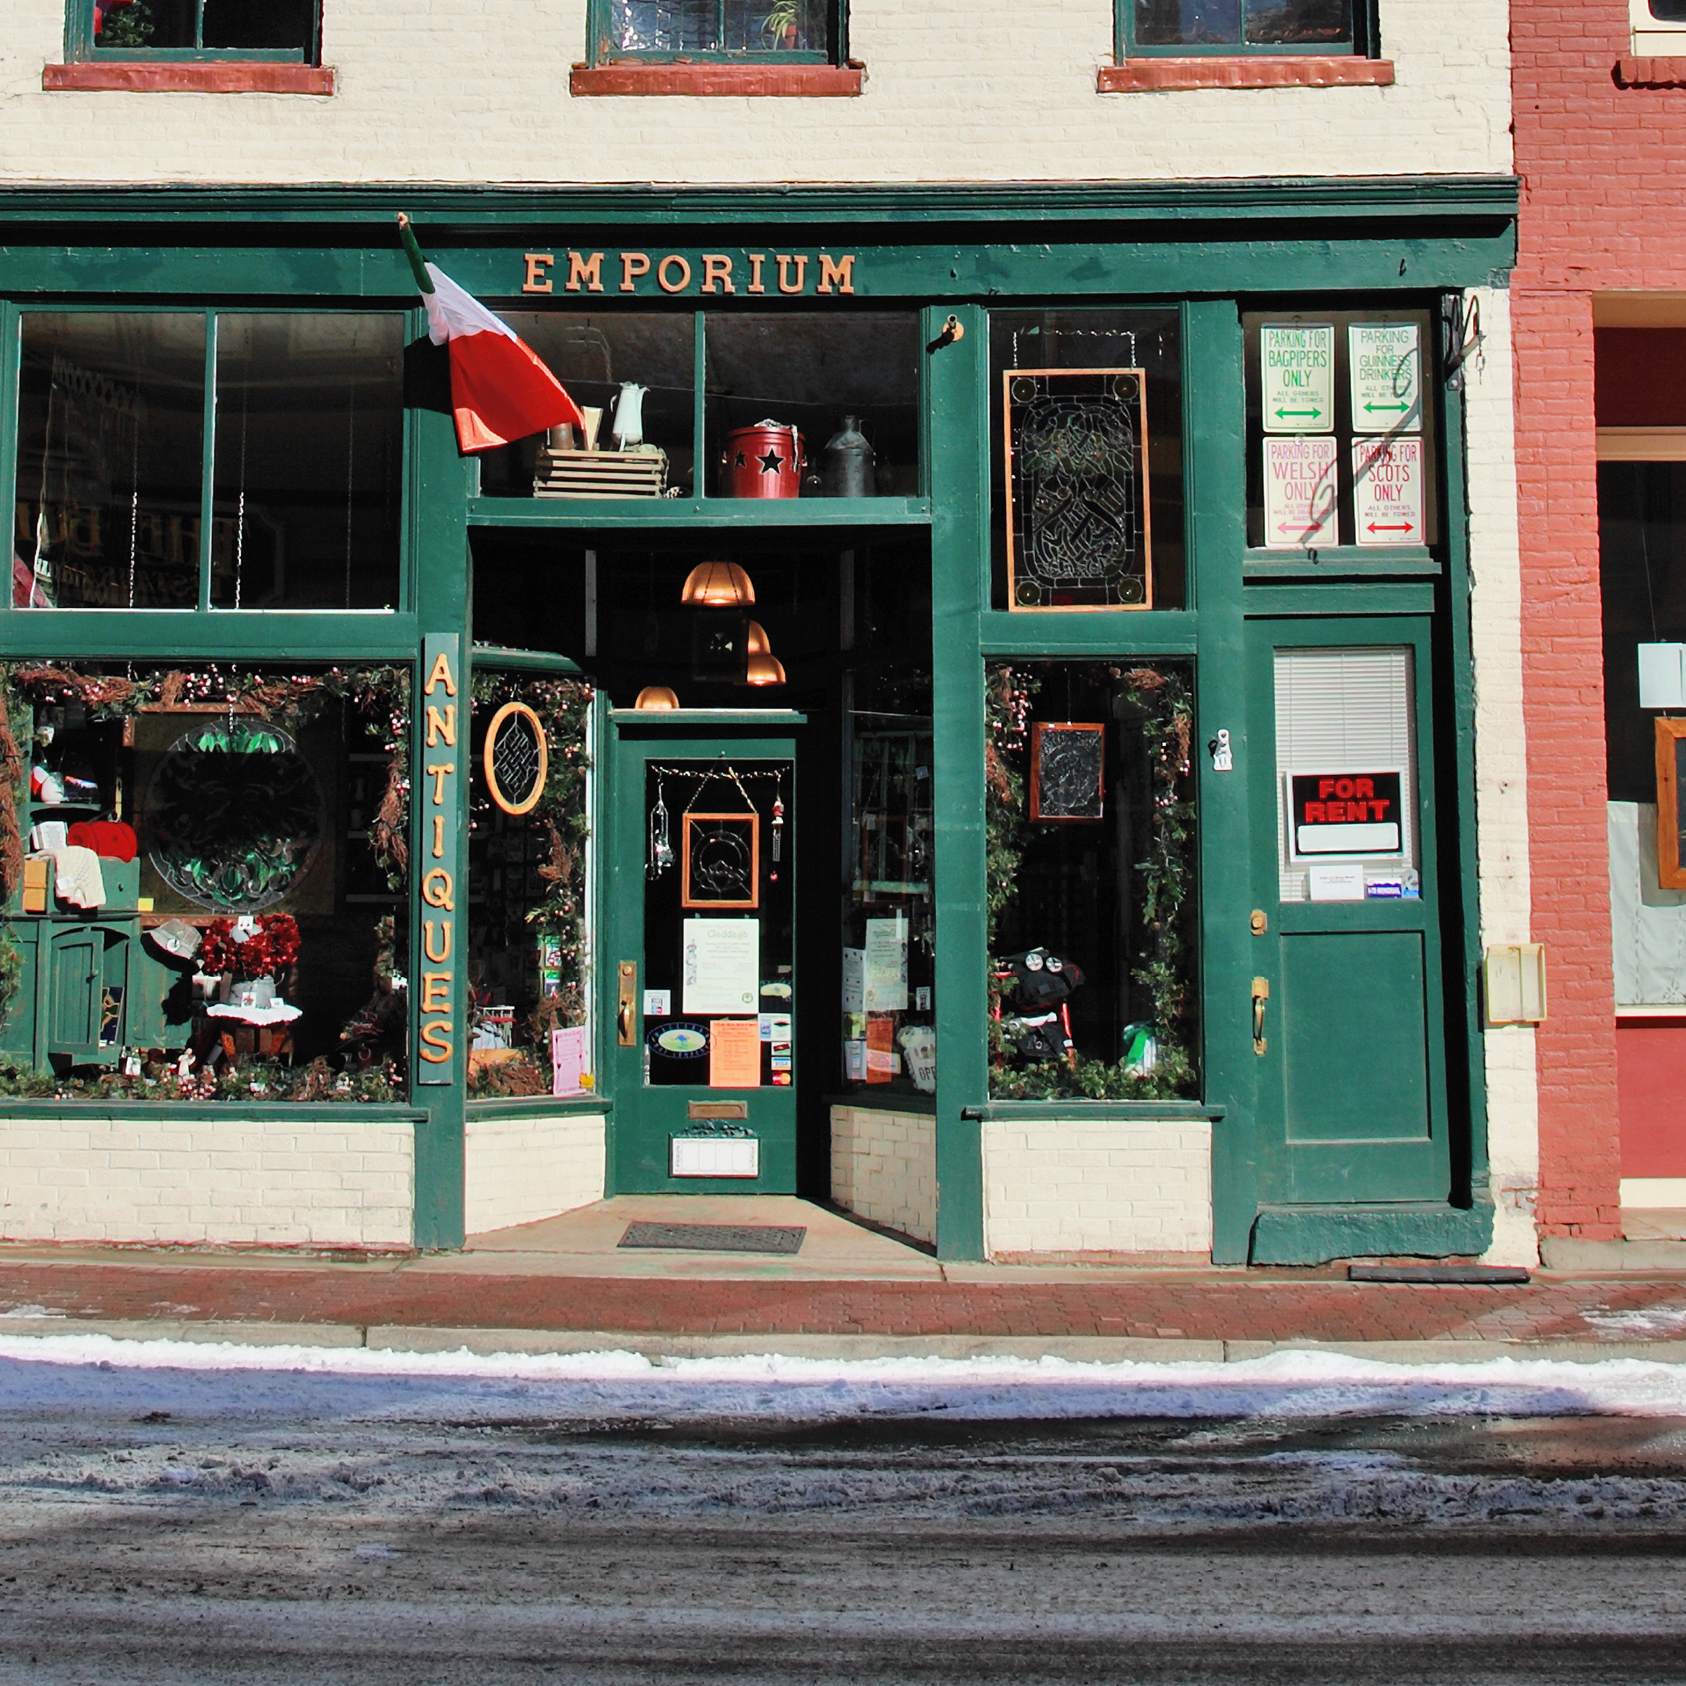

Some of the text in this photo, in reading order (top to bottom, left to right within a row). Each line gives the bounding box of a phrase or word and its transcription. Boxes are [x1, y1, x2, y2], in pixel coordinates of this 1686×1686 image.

[522, 251, 855, 295] EMPORIUM
[1269, 330, 1326, 348] PARKING FOR
[1361, 330, 1409, 343] PARKING
[1269, 350, 1327, 367] BAGPIPERS
[1376, 345, 1394, 354] FOR
[1360, 355, 1411, 367] GUINNESS
[1283, 369, 1312, 387] ONLY
[1359, 368, 1412, 381] DRINKERS
[1271, 444, 1330, 459] PARKING FOR
[1400, 445, 1417, 462] FOR
[1273, 462, 1329, 480] WELSH
[1368, 464, 1410, 482] SCOTS
[1285, 482, 1318, 500] ONLY
[1374, 484, 1403, 501] ONLY
[1318, 778, 1374, 798] FOR
[1305, 799, 1390, 824] RENT
[420, 652, 456, 1064] ANTIQUES
